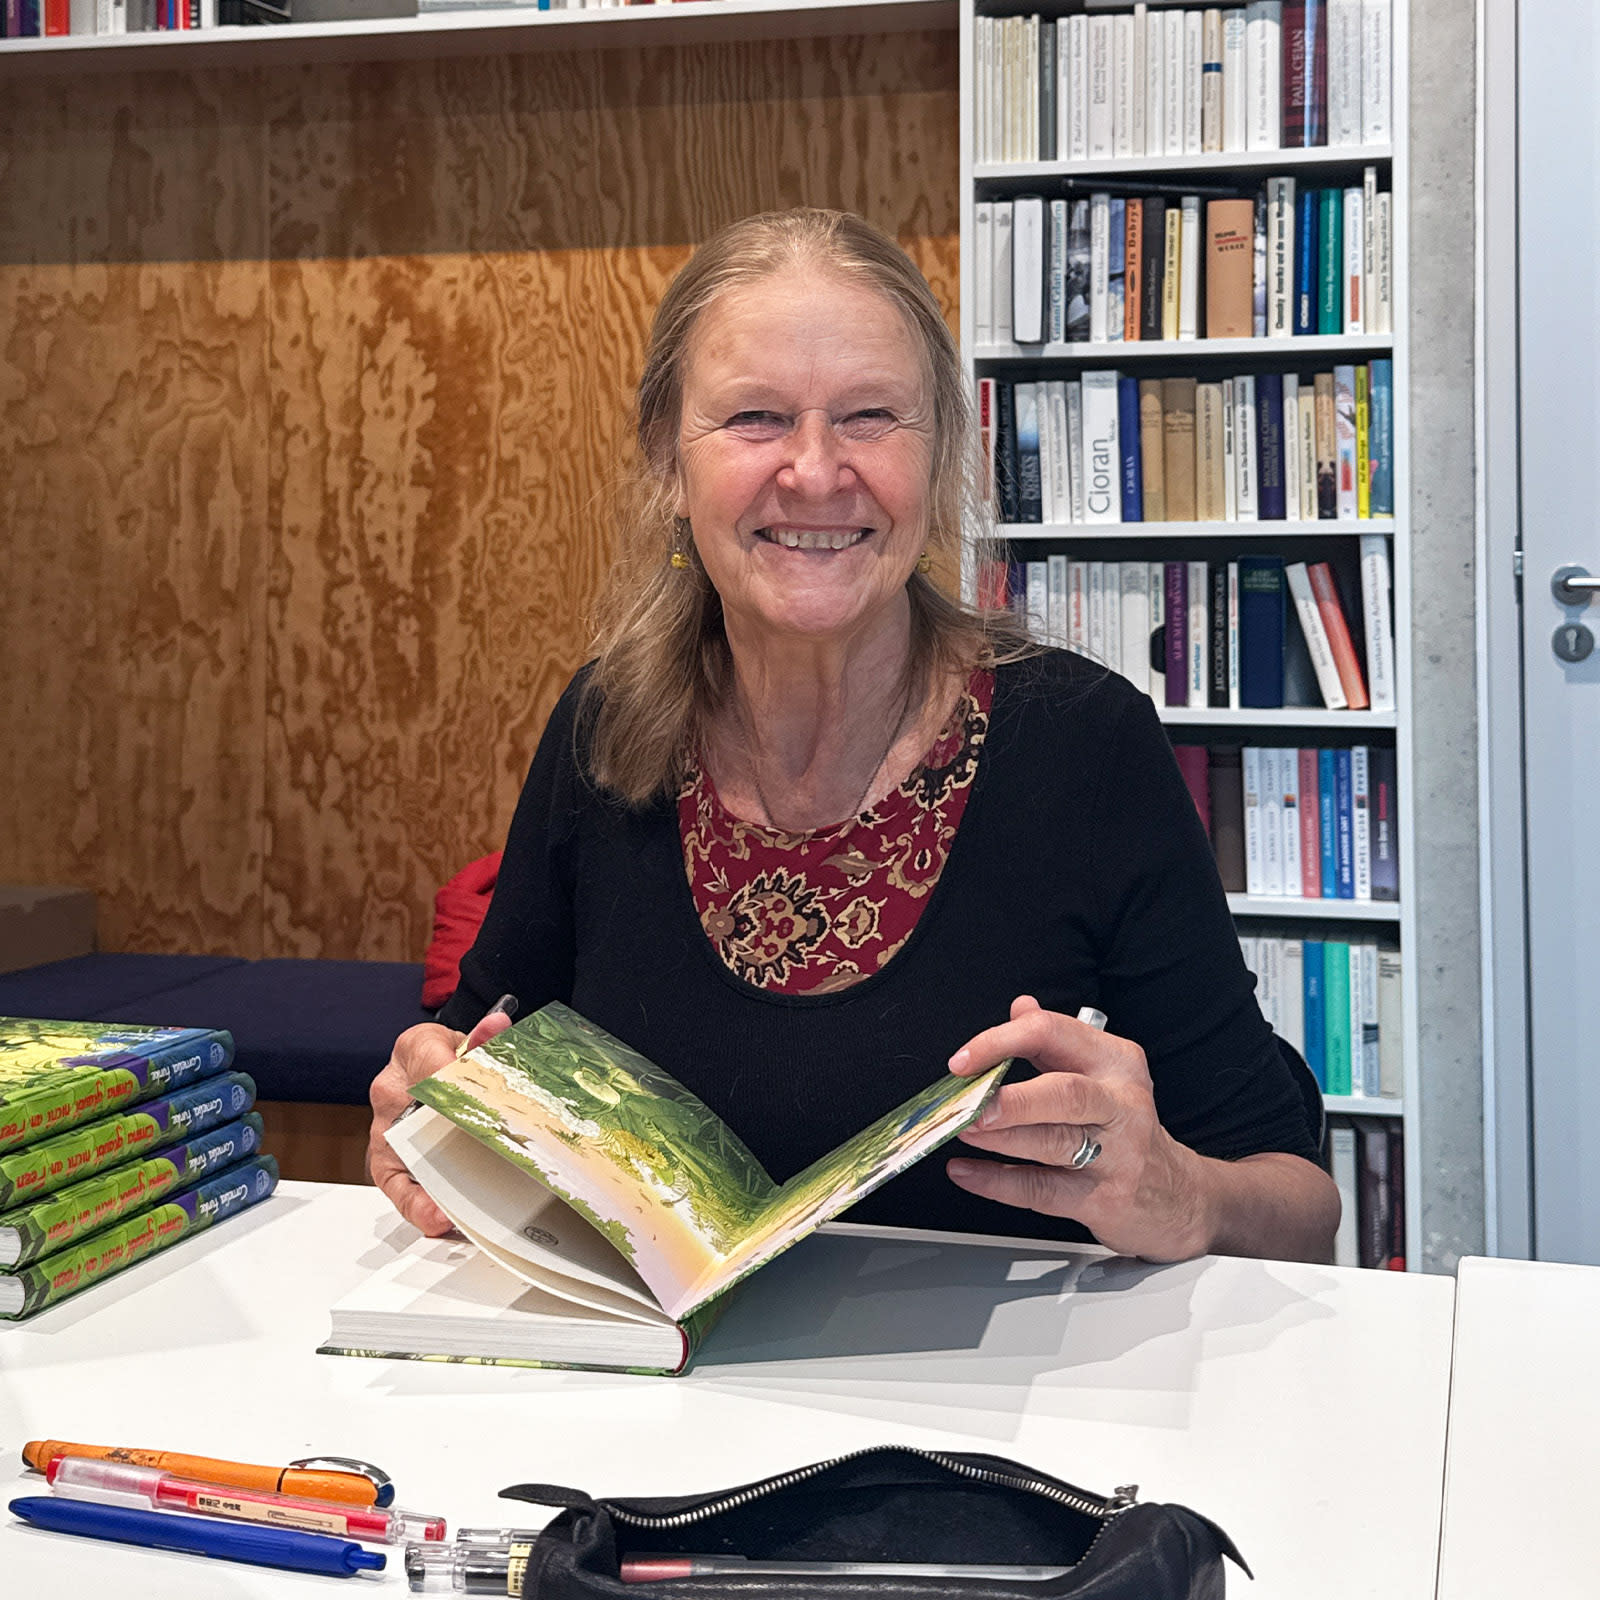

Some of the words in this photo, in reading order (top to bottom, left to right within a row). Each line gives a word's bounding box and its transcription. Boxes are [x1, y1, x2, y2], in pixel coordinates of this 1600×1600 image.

[1291, 72, 1304, 106] PAUL
[1050, 273, 1063, 303] Celati
[1050, 305, 1063, 341] Gianni
[1088, 439, 1111, 514] Cioran
[151, 1066, 170, 1083] Funke
[172, 1056, 201, 1075] Cornelia
[72, 1080, 103, 1118] glaubt
[107, 1080, 133, 1101] Emma
[46, 1103, 71, 1128] nicht
[171, 1109, 192, 1126] Funke
[193, 1098, 223, 1118] Cornelia
[30, 1114, 43, 1128] an
[92, 1125, 123, 1166] glaubt
[127, 1124, 154, 1147] Emma
[65, 1150, 91, 1176] nicht
[189, 1153, 206, 1173] Funke
[208, 1141, 234, 1162] Cornelia
[16, 1166, 46, 1191] Feen
[50, 1161, 63, 1175] an
[148, 1169, 173, 1192] Emma
[117, 1171, 145, 1214] glaubt
[220, 1184, 248, 1207] Cornelia
[78, 1209, 91, 1224] an
[91, 1198, 116, 1224] nicht
[200, 1198, 219, 1217] Funke
[48, 1216, 75, 1242] Feen
[158, 1215, 183, 1238] Emma
[126, 1218, 154, 1260] glaubt
[86, 1257, 98, 1272] an
[100, 1243, 124, 1273] nicht
[53, 1264, 81, 1289] Feen
